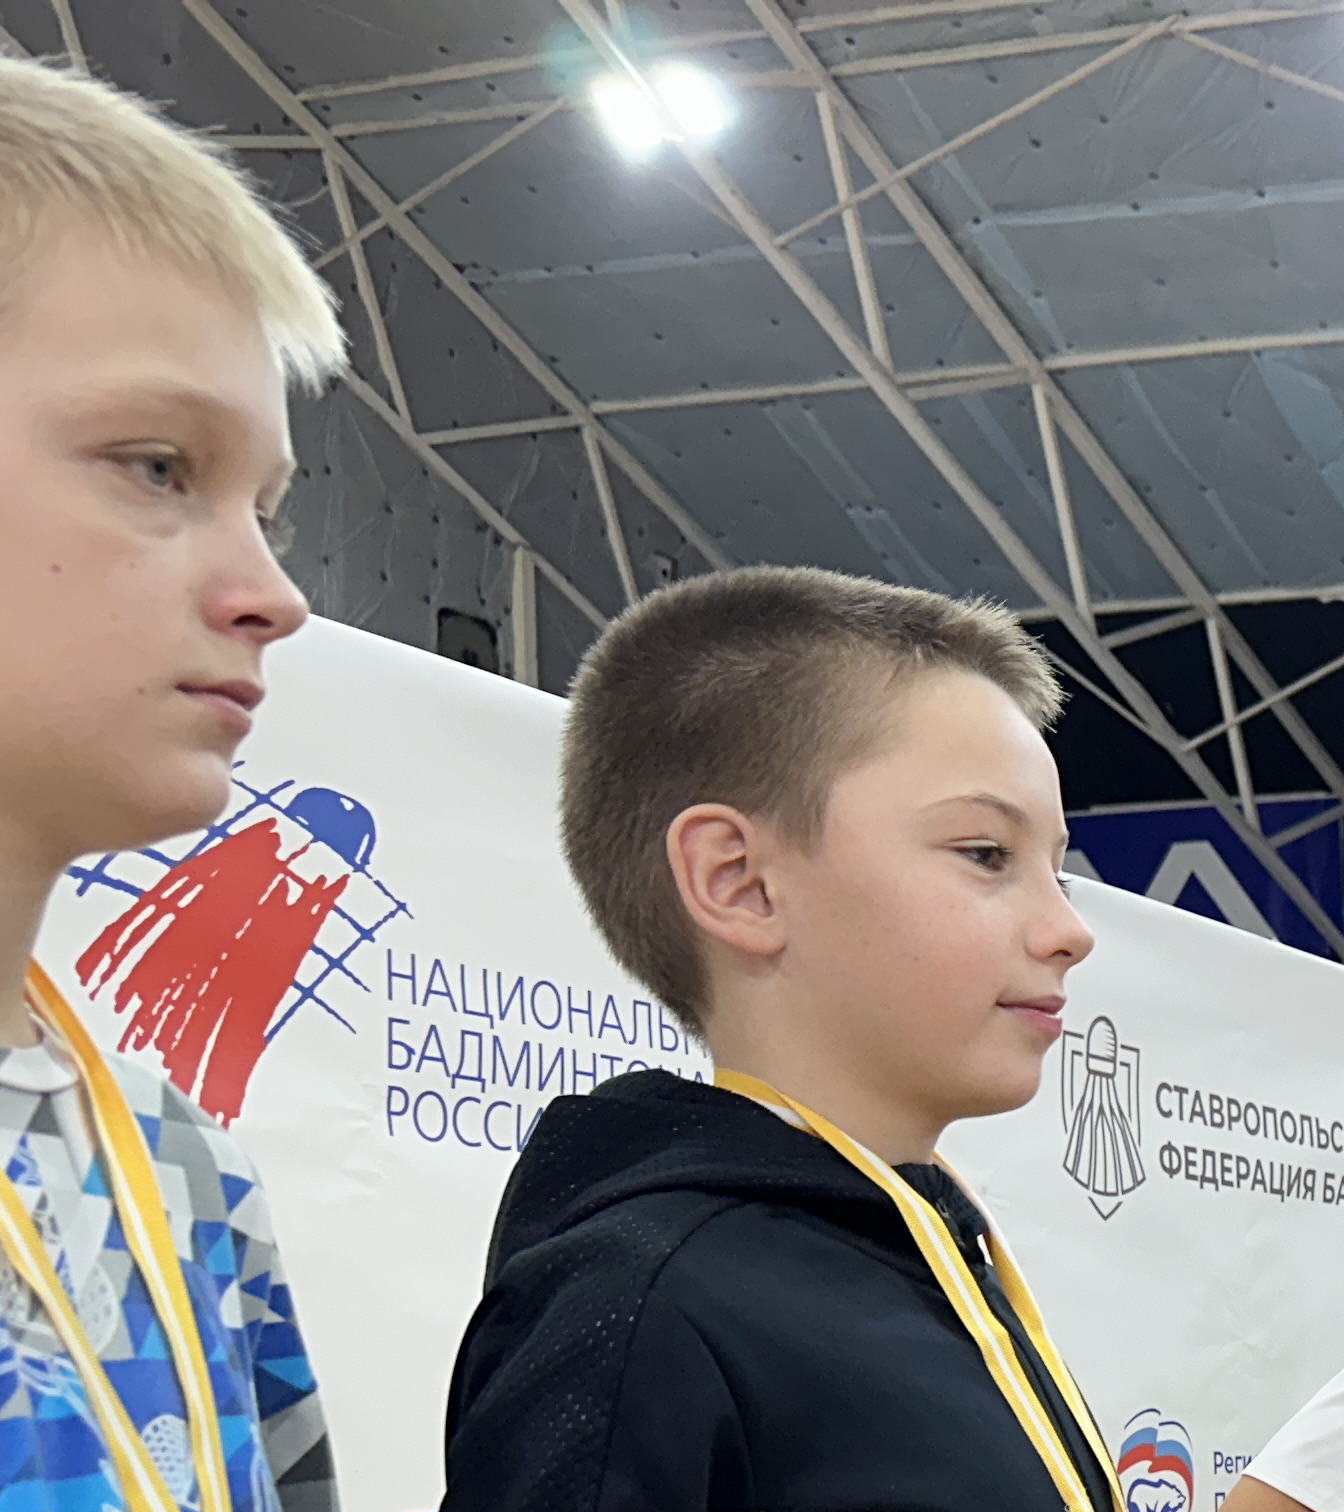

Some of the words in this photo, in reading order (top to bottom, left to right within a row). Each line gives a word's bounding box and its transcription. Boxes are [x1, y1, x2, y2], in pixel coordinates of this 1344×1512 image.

[387, 1016, 704, 1095] БАДМИНТ
[386, 1085, 544, 1152] РОССИ
[1158, 1141, 1316, 1202] ФЕДЕРАЦИЯ
